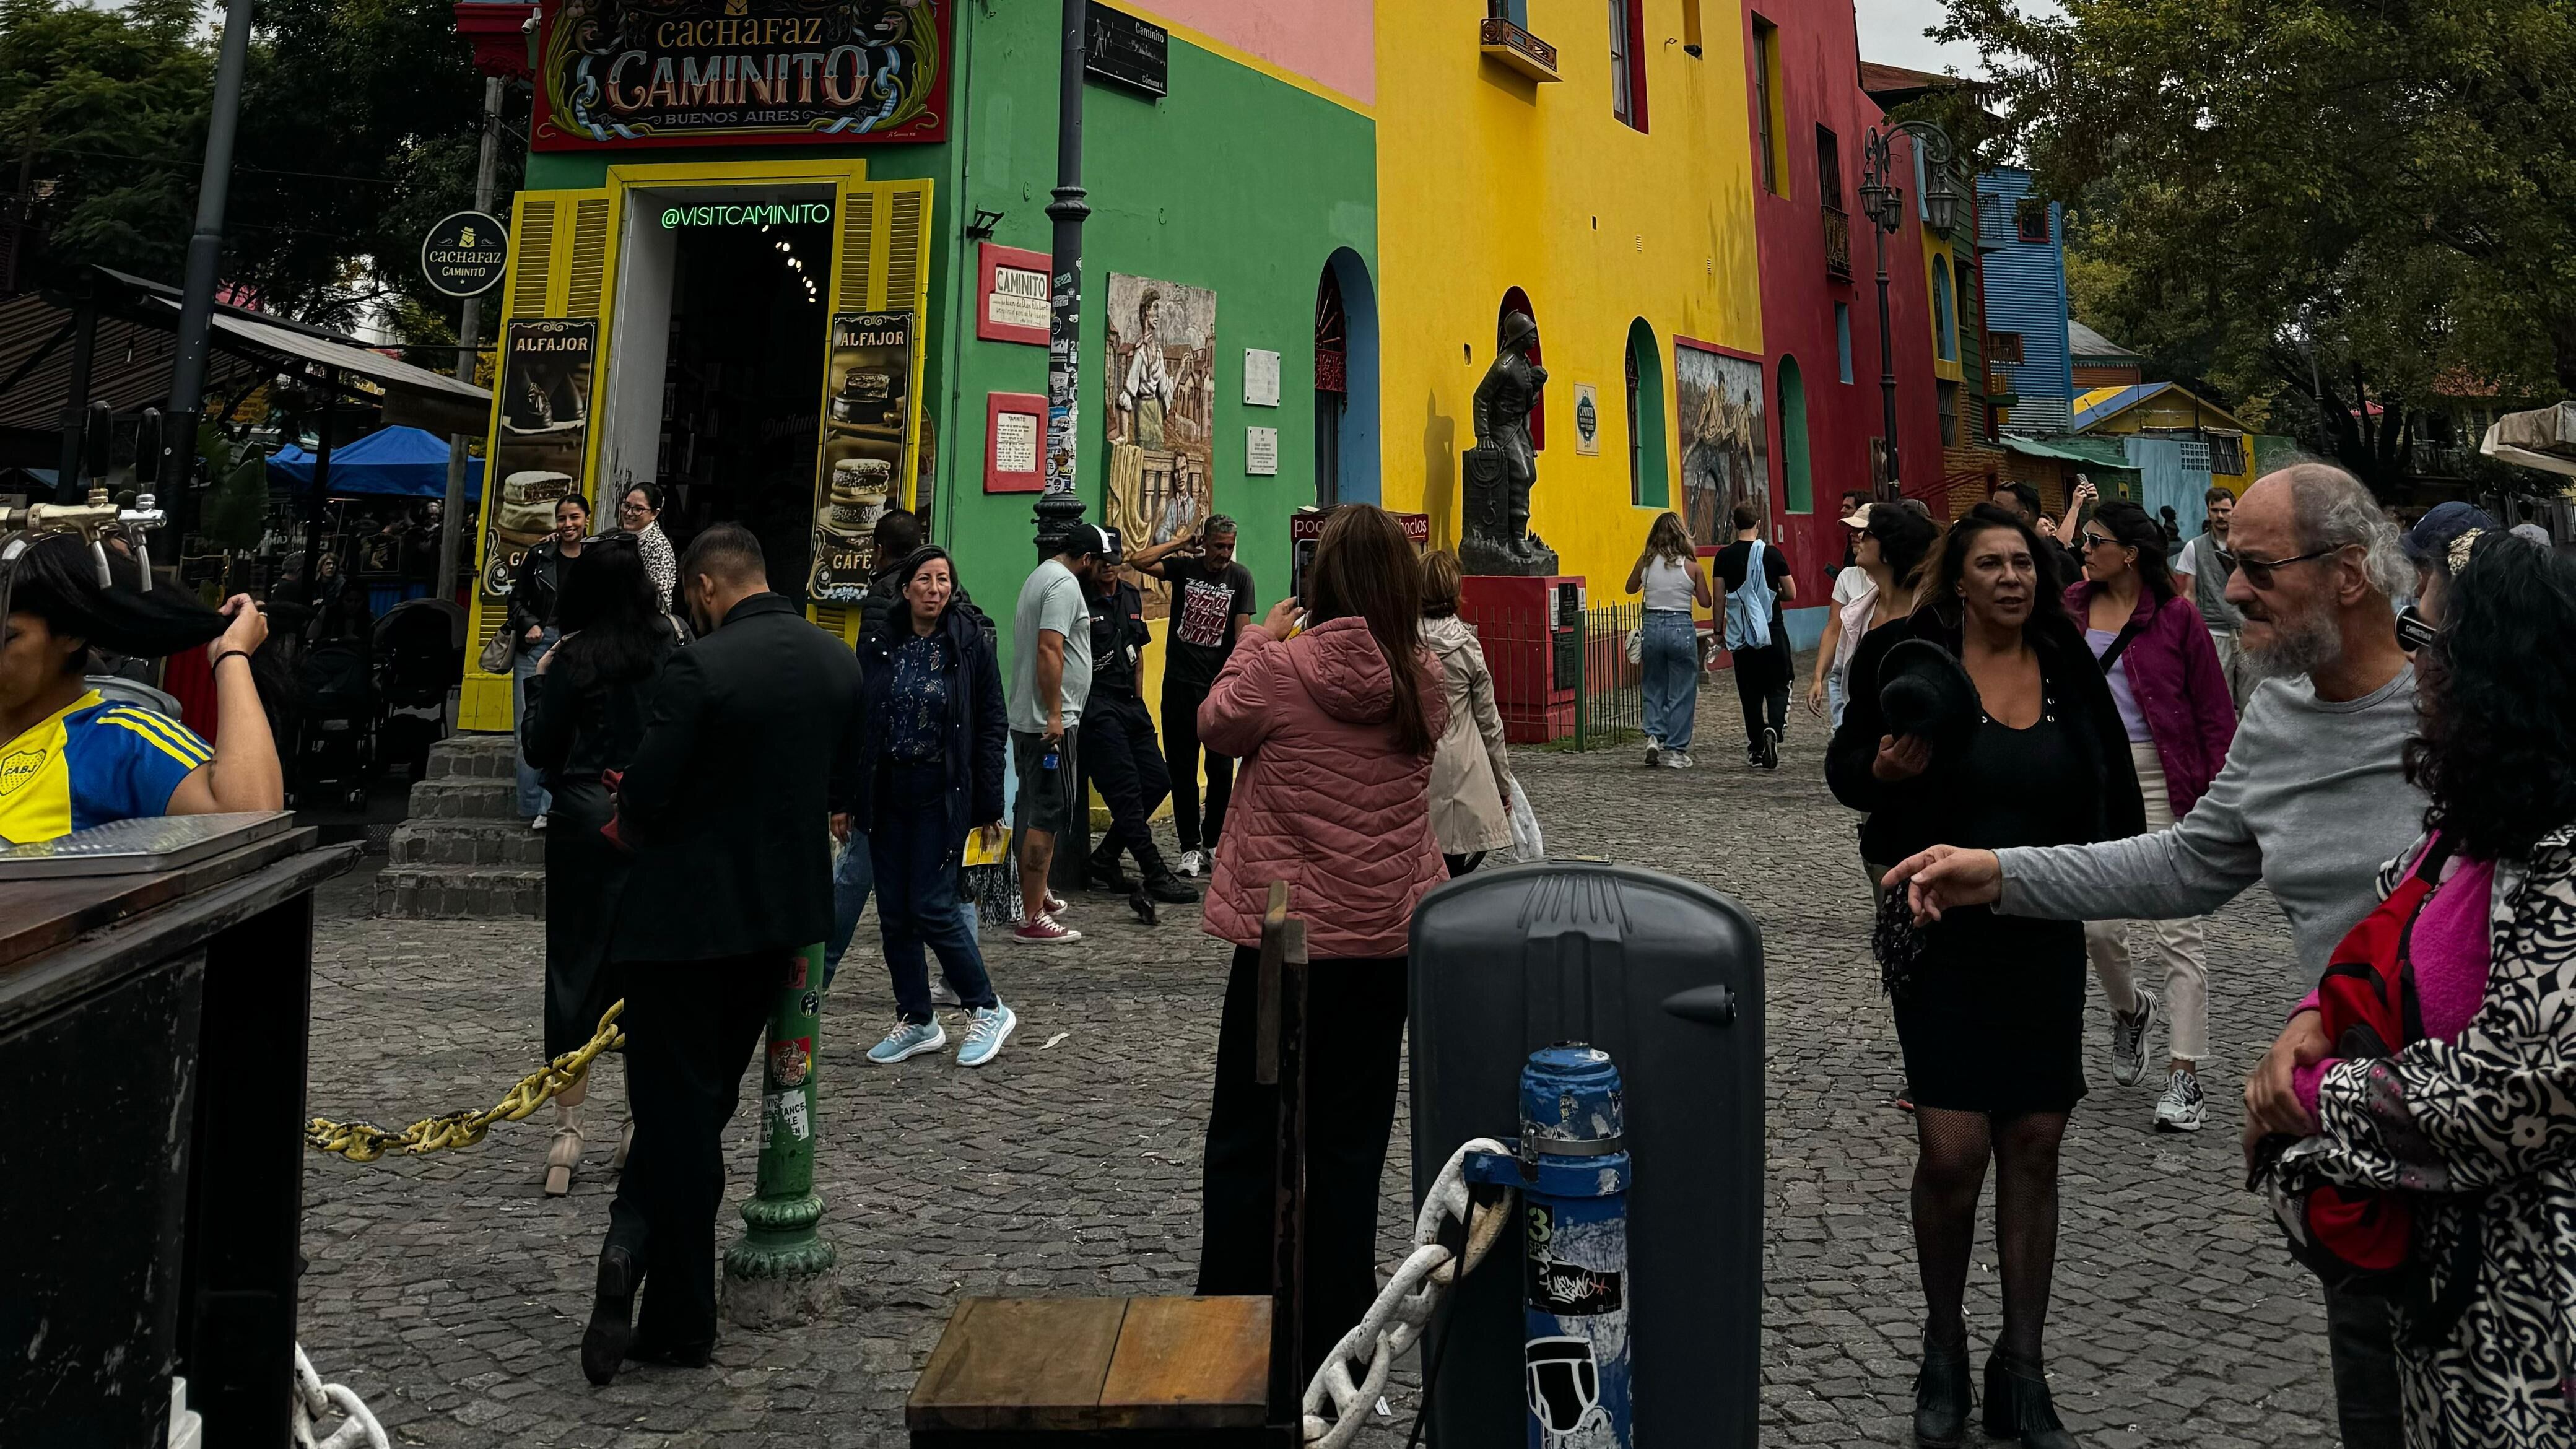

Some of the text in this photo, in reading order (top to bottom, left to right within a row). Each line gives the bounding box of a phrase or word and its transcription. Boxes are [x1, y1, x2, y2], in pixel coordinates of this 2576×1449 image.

[1135, 22, 1164, 43] Caminito
[605, 45, 870, 115] CAMINITO
[665, 110, 799, 124] BUENOS AIRES
[661, 204, 830, 228] @VISITCAMINITO
[442, 266, 485, 277] CAMINITO
[996, 269, 1046, 298] CAMINITO
[516, 337, 588, 352] ALFAJOR
[840, 331, 904, 347] ALFAJOR
[3, 764, 38, 776] CABJ
